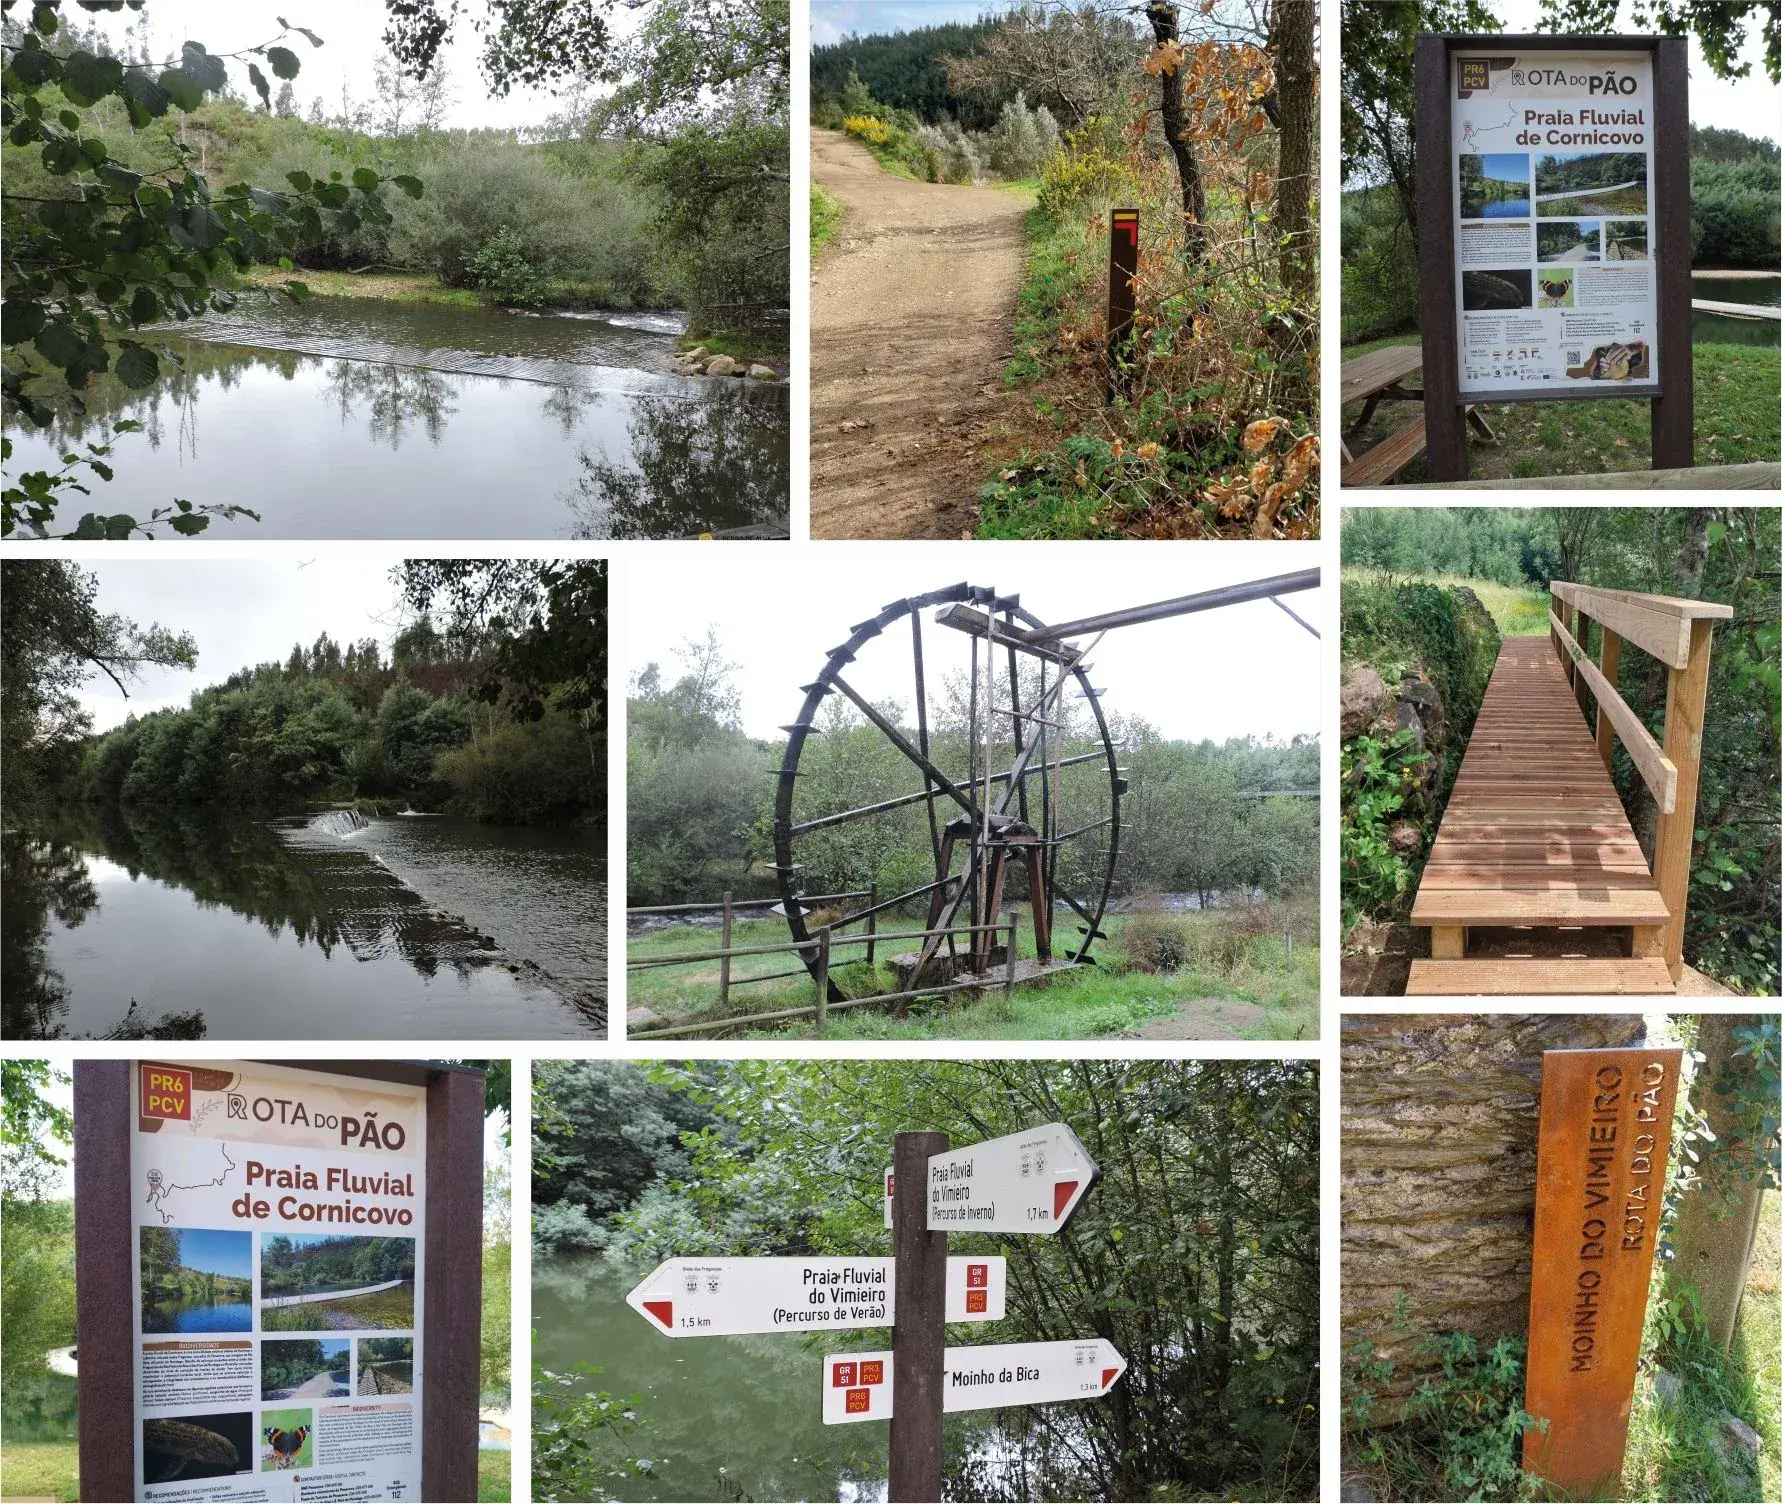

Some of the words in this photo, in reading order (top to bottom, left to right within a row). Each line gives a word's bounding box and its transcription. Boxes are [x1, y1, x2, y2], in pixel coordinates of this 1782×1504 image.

[1464, 64, 1484, 74] PR6
[1464, 76, 1485, 87] PCV
[1511, 70, 1566, 85] ROTA
[1570, 76, 1587, 85] DO
[1589, 71, 1637, 95] PÃO
[1525, 110, 1573, 125] Praia
[1580, 109, 1645, 125] Fluvial
[1516, 130, 1541, 145] de
[1547, 129, 1644, 145] Cornicovo
[150, 1074, 183, 1093] PR6
[1633, 1062, 1666, 1123] PÃO
[149, 1095, 185, 1114] PCV
[227, 1093, 310, 1127] ROTA
[314, 1113, 338, 1129] DO
[341, 1112, 406, 1150] PÃO
[1584, 1064, 1624, 1208] VIMIEIRO
[1631, 1134, 1656, 1176] DO
[246, 1160, 318, 1191] Praia
[326, 1167, 414, 1196] Fluvial
[932, 1166, 948, 1183] Praia
[950, 1158, 973, 1179] Fluvial
[932, 1188, 940, 1202] do
[941, 1183, 970, 1202] Vimieiro
[232, 1193, 270, 1219] de
[278, 1196, 413, 1226] Cornicovo
[932, 1205, 957, 1221] (Percurso
[958, 1206, 966, 1219] de
[967, 1201, 995, 1220] Inverno)
[1027, 1208, 1036, 1221] 1,7
[1038, 1207, 1048, 1219] km
[1621, 1184, 1648, 1252] ROTA
[1580, 1219, 1607, 1261] DO
[803, 1269, 838, 1285] Praia
[844, 1267, 886, 1284] Fluvial
[809, 1288, 824, 1304] do
[830, 1287, 886, 1303] Vimieiro
[681, 1317, 695, 1328] 1,5
[697, 1317, 710, 1326] km
[774, 1308, 830, 1324] (Percurso
[834, 1307, 846, 1319] de
[851, 1304, 886, 1319] Verão)
[1571, 1270, 1603, 1373] MOINHO
[864, 1364, 879, 1372] PR3
[952, 1369, 994, 1387] Moinho
[999, 1368, 1012, 1382] da
[1017, 1366, 1039, 1381] Bica
[841, 1376, 849, 1384] 51
[864, 1374, 879, 1382] PCV
[850, 1401, 865, 1411] PCV
[392, 1491, 401, 1499] 112
